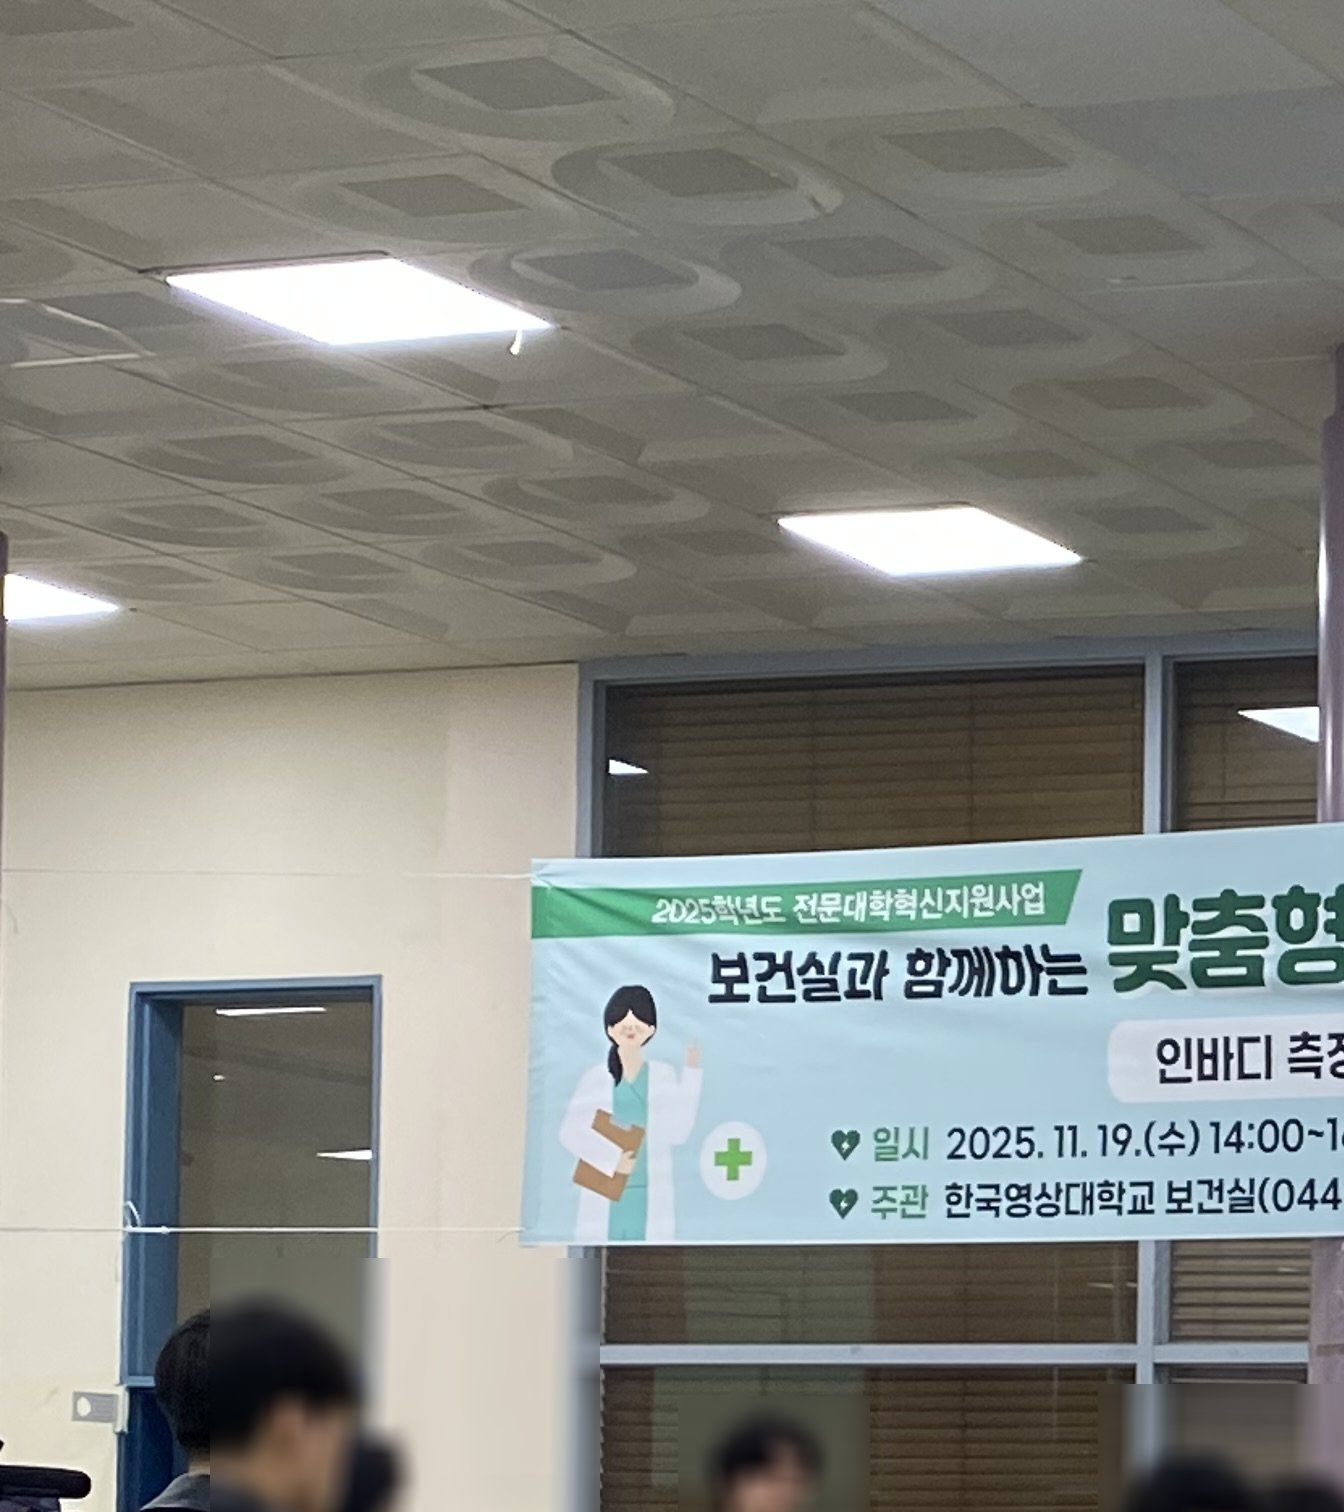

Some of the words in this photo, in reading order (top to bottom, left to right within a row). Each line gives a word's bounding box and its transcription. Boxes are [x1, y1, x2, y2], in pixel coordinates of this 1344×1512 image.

[651, 894, 786, 926] 2025학년도
[793, 881, 1046, 924] 전문대학혁신지원사업
[707, 949, 890, 1004] 보건실과
[903, 942, 1089, 1000] 함께하는
[1156, 1034, 1273, 1085] 인바디
[872, 1126, 930, 1162] 일시
[870, 1183, 930, 1220] 주관
[944, 1179, 1156, 1219] 한국영상대학교
